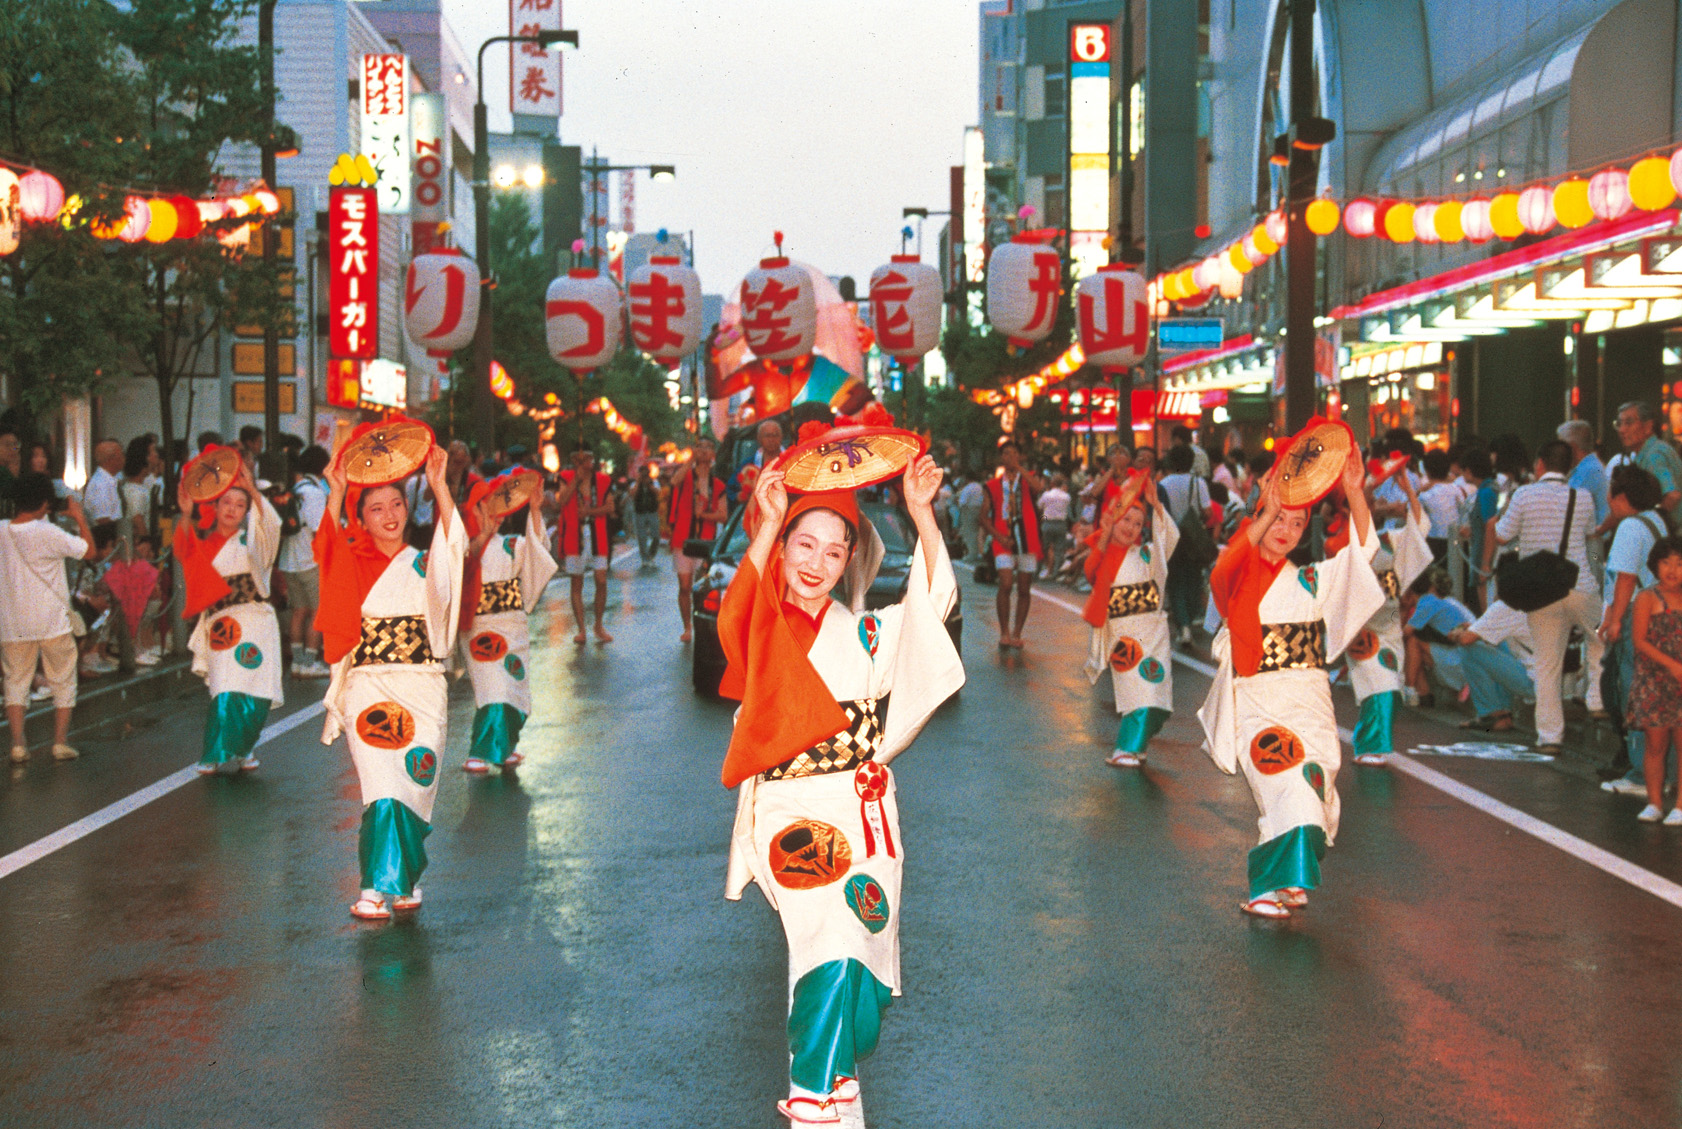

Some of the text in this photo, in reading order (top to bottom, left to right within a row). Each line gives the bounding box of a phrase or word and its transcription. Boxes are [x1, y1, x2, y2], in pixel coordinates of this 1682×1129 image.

[416, 138, 442, 206] ZOO
[340, 194, 369, 352] モスバーガー
[405, 263, 466, 339] り
[546, 300, 605, 358] つ
[629, 272, 686, 352] ま
[740, 277, 803, 355] 笠
[1079, 278, 1150, 355] 山
